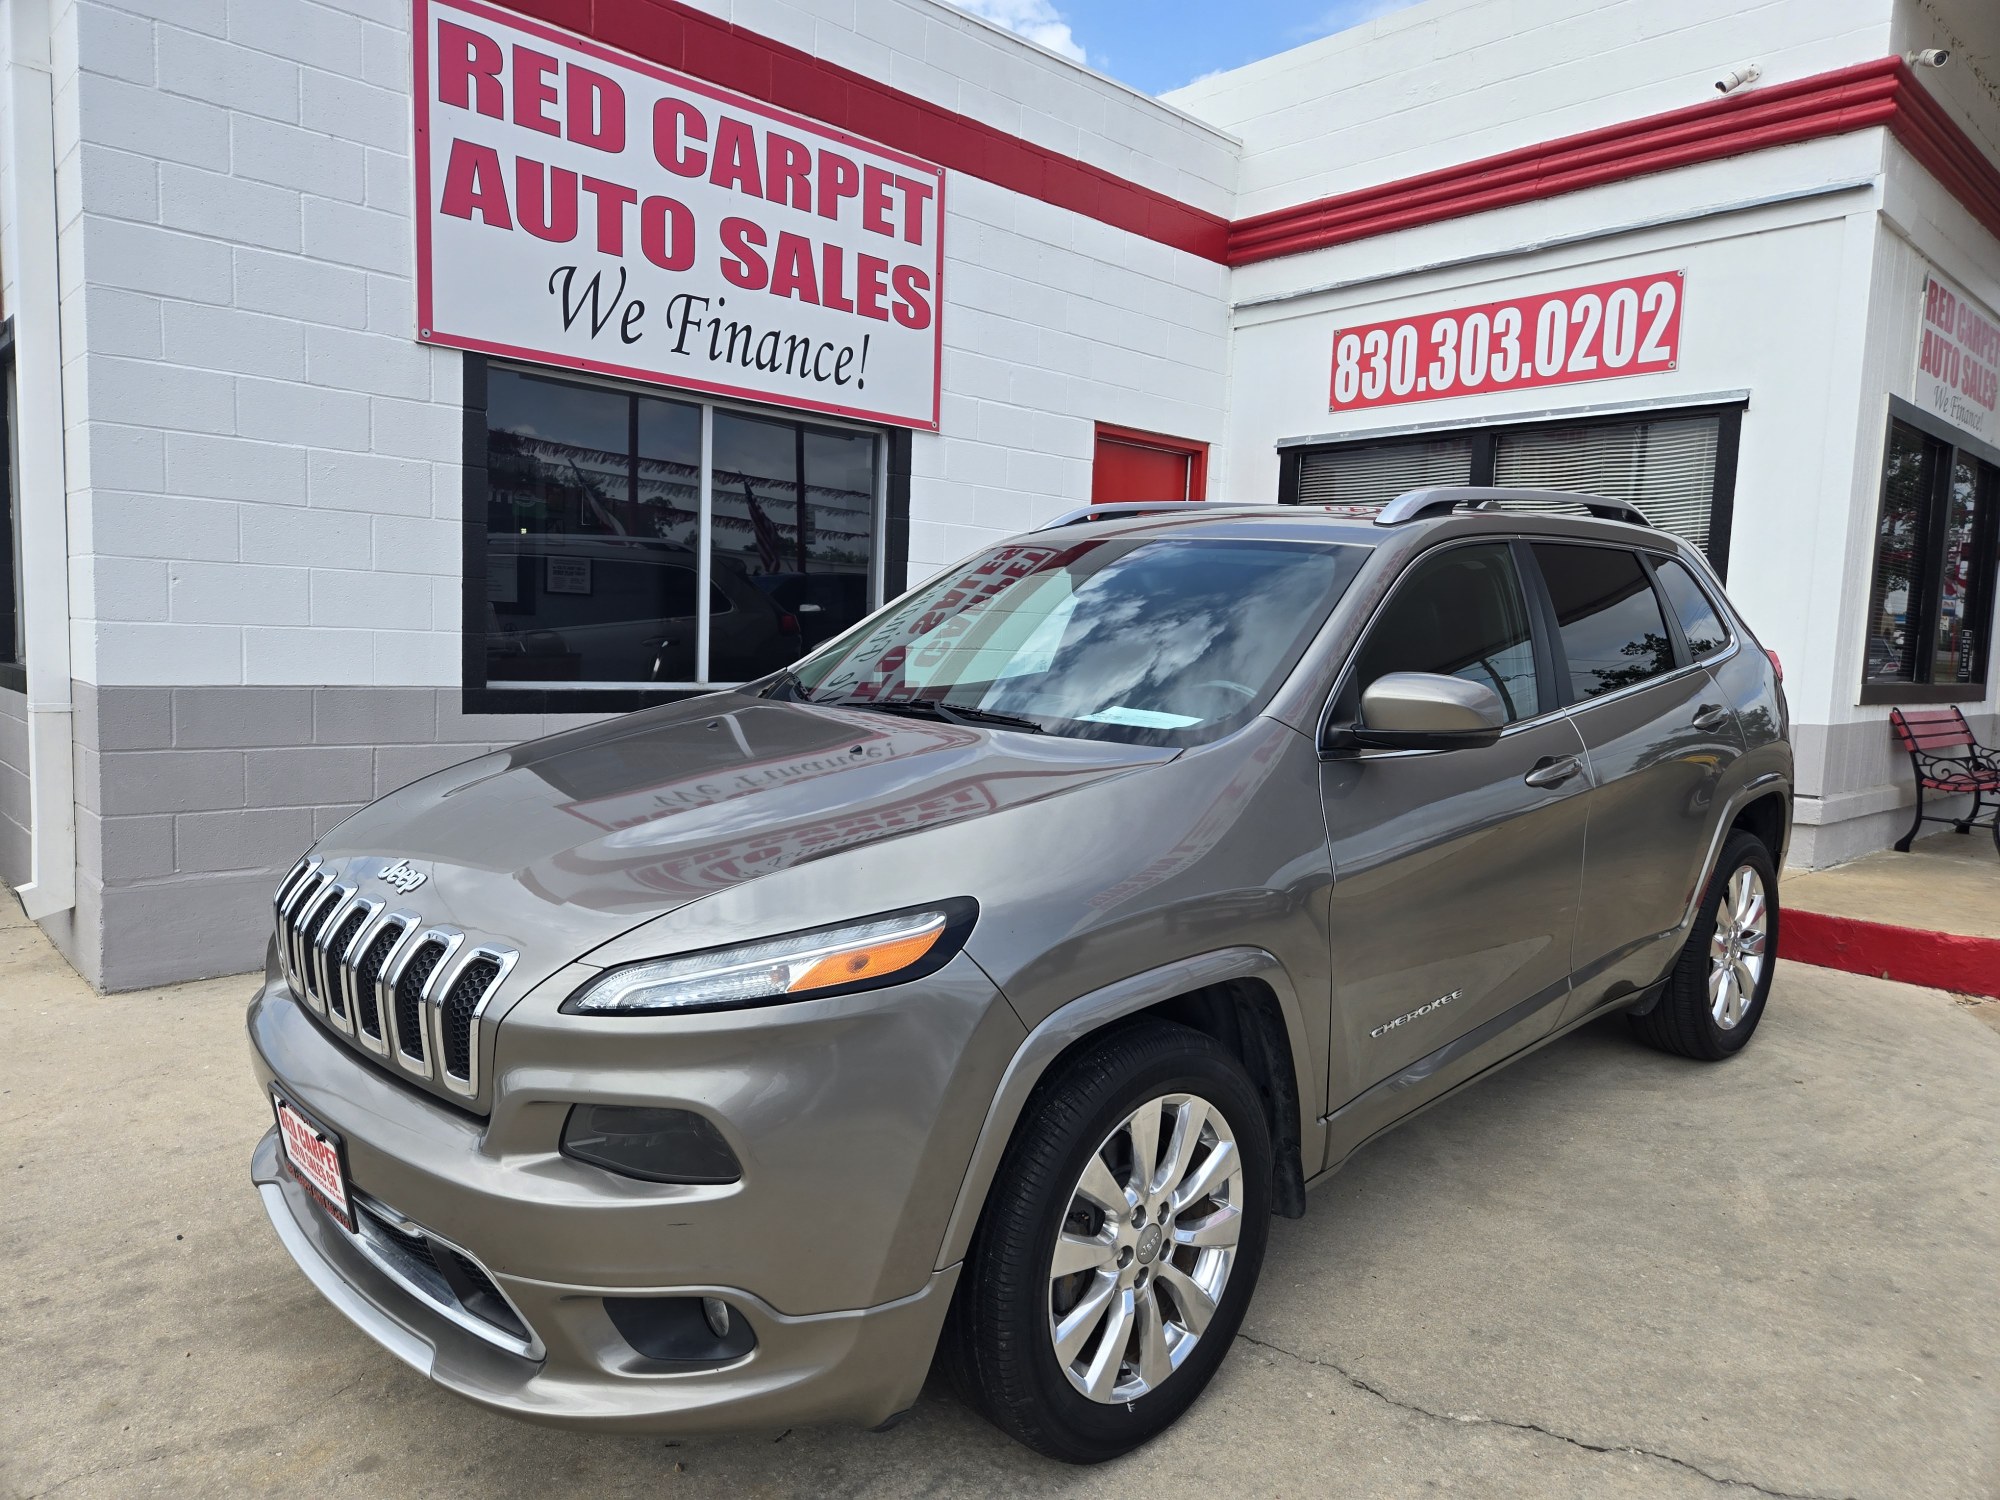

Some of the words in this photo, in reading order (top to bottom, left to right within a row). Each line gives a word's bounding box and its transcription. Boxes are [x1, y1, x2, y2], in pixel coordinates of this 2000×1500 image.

[437, 18, 626, 154] RED
[652, 96, 934, 246] CARPET
[440, 137, 696, 272] AUTO
[719, 216, 932, 330] SALES
[548, 265, 646, 344] We
[666, 293, 871, 390] Finance!
[1334, 280, 1677, 404] 830.303.0202
[1925, 278, 1957, 336] RED
[1957, 302, 2000, 368] CARPET
[1920, 328, 1961, 389] AUTO
[1961, 355, 1998, 412] SALES
[1933, 385, 1949, 414] We
[1950, 395, 1984, 432] Finance!
[377, 859, 428, 895] Jeep
[1370, 988, 1463, 1038] CHEROKEE
[298, 1123, 341, 1177] CARPET
